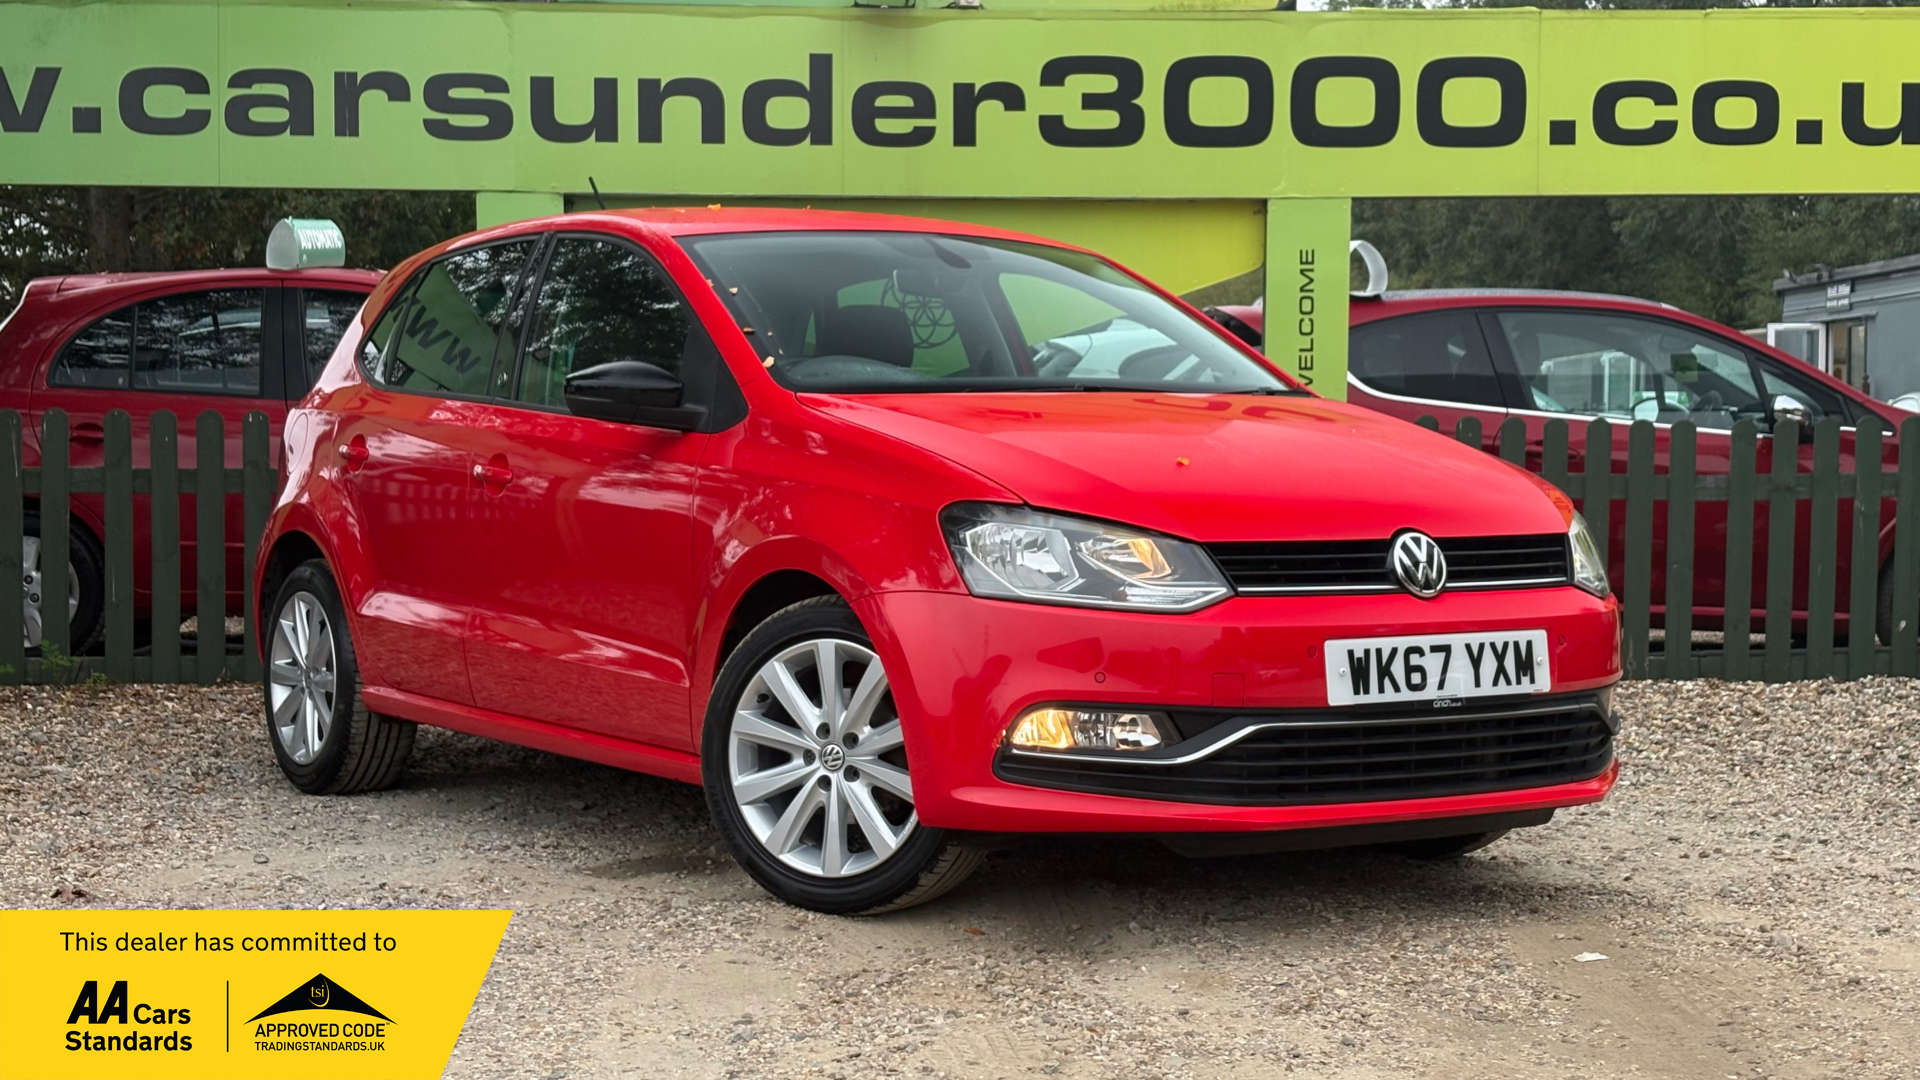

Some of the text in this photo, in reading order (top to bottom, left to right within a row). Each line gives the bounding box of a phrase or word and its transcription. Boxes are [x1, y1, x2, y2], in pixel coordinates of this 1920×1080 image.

[298, 229, 342, 250] AUTOMATIC
[1347, 639, 1536, 696] WK67 YXM
